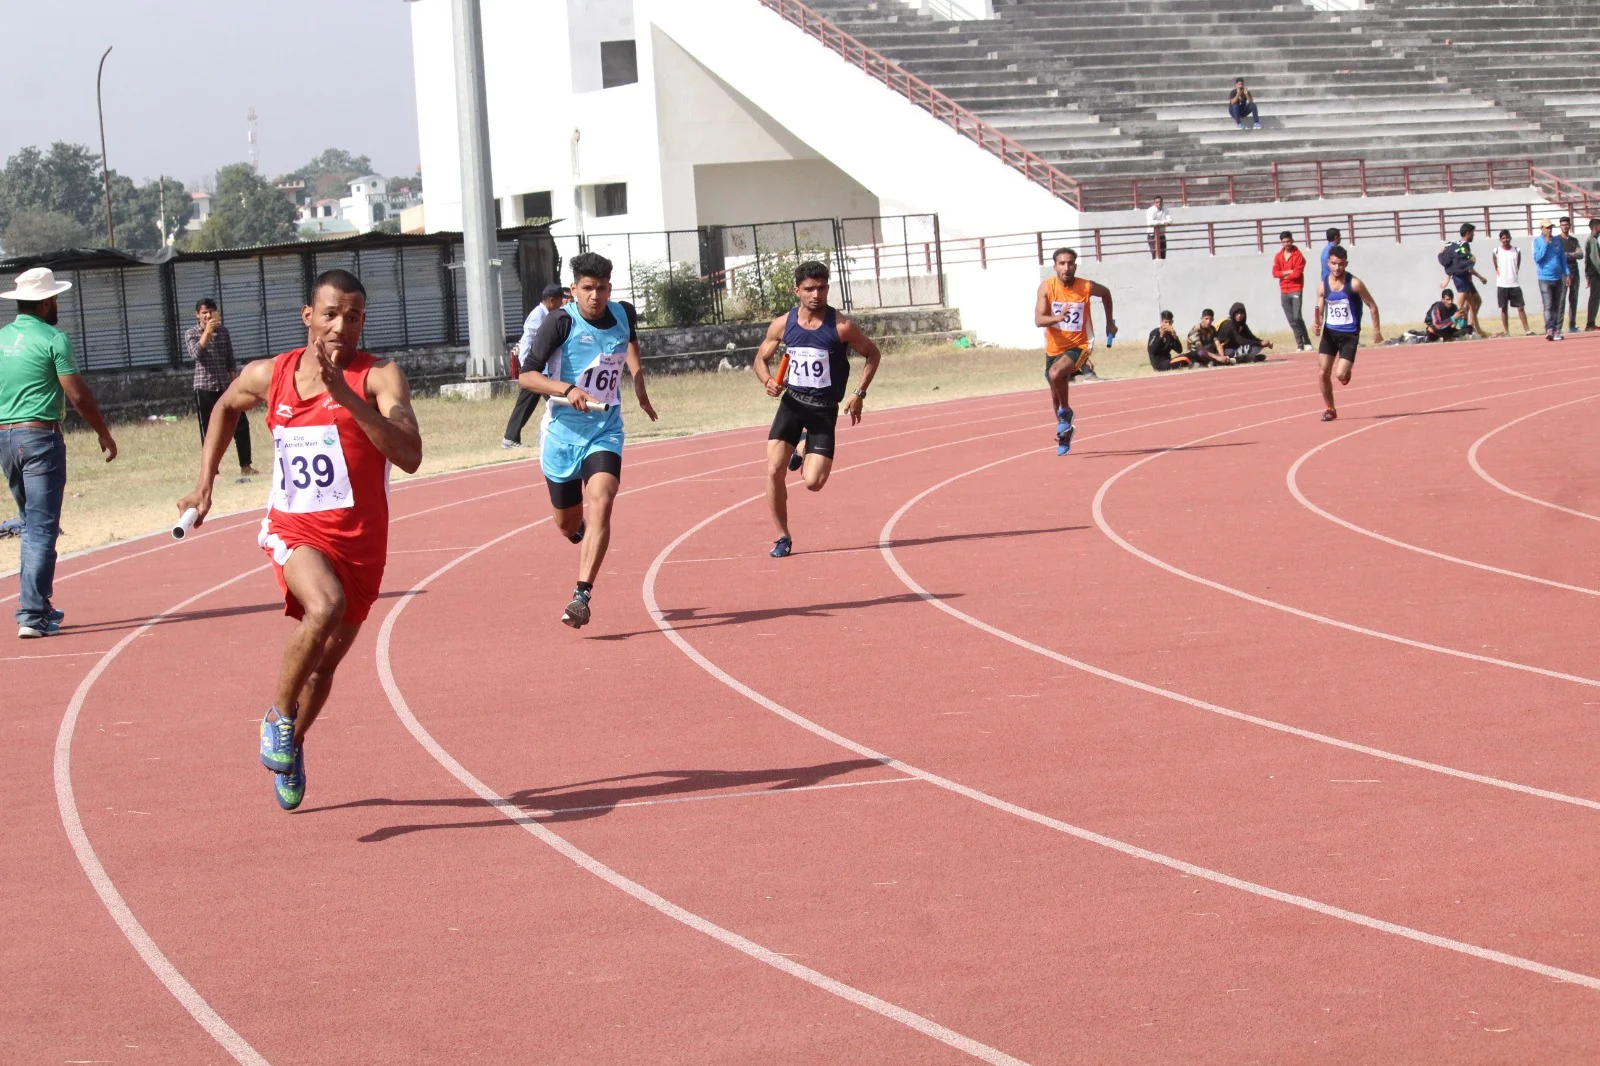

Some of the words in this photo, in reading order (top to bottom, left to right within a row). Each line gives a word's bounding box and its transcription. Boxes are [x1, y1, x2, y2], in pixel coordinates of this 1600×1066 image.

[1329, 307, 1349, 318] 263
[790, 359, 824, 378] 219
[583, 367, 619, 392] 166
